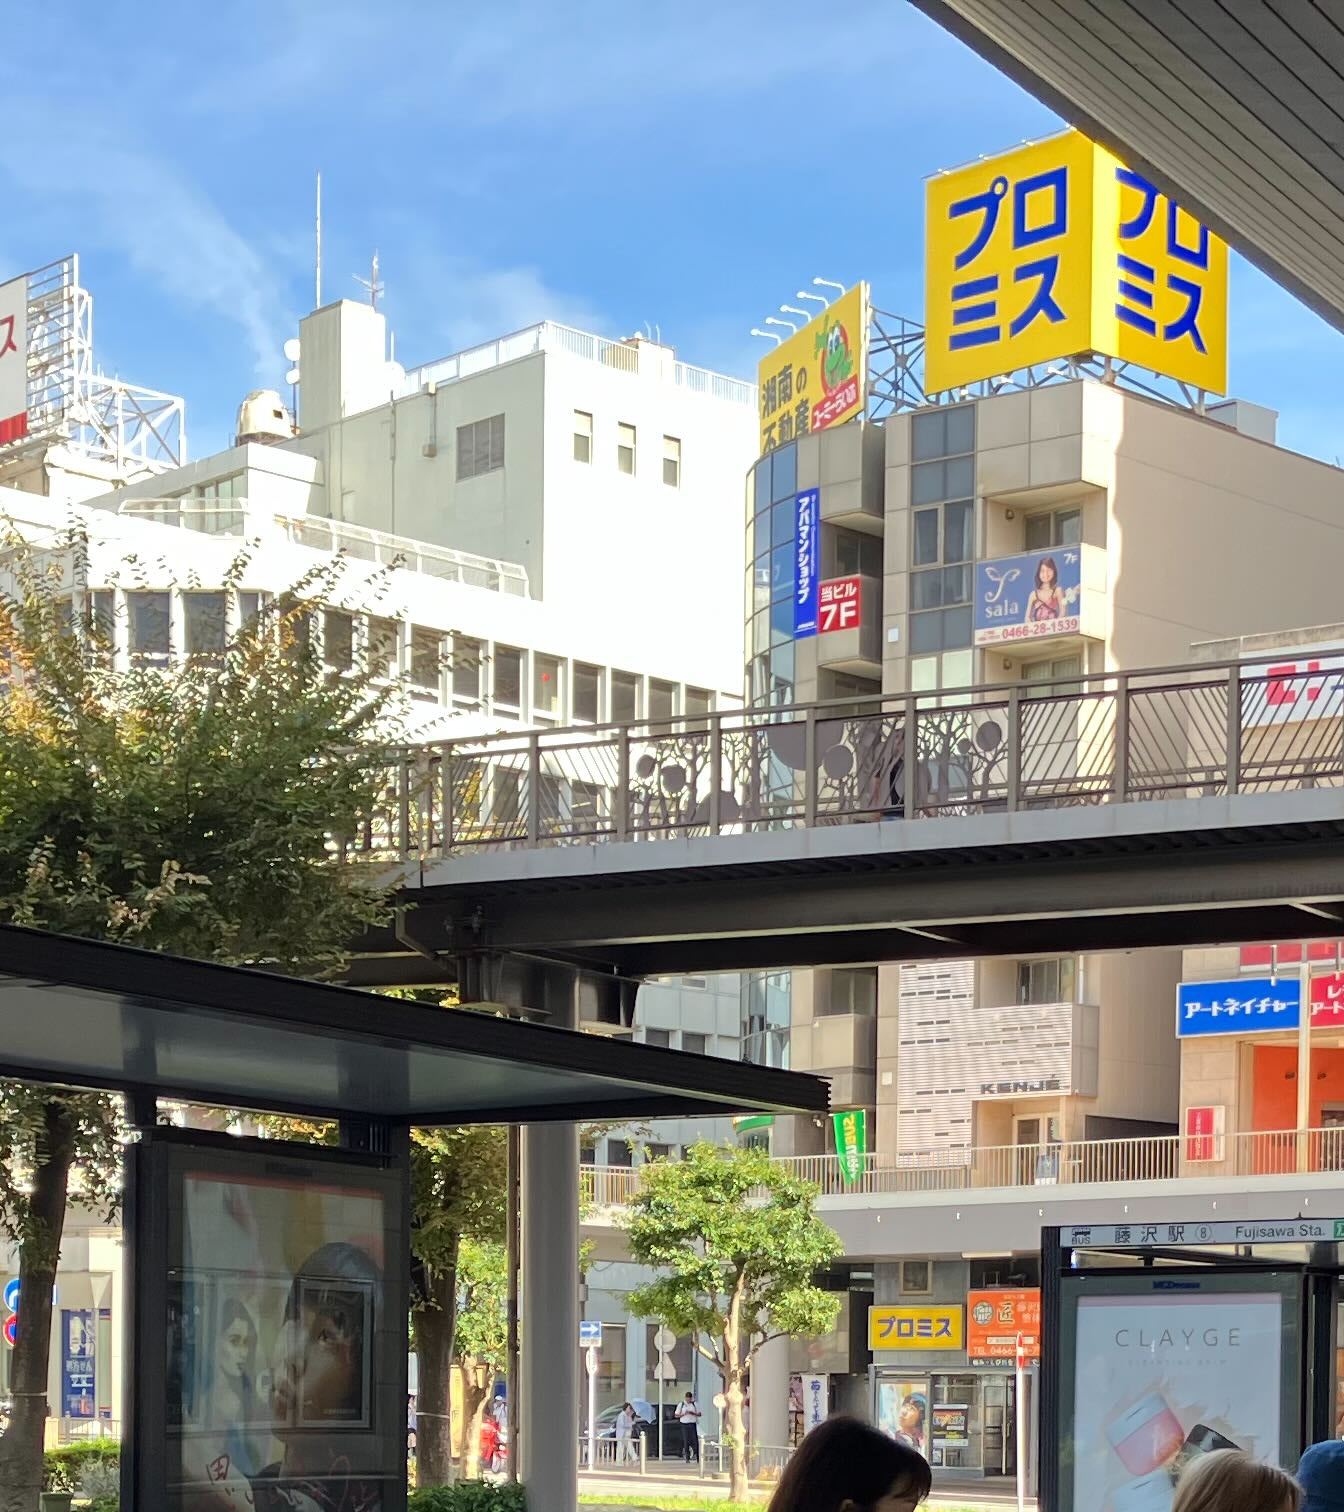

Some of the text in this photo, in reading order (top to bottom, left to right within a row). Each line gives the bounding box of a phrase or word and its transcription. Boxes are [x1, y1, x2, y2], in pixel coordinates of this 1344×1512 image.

[947, 164, 1069, 273] プロ
[948, 253, 1068, 352] ミス
[1114, 253, 1208, 356] ミス
[762, 397, 810, 453] 不動産
[797, 496, 811, 605] アパマンショップ
[1063, 552, 1078, 565] 7F
[820, 582, 857, 603] 当ビル
[819, 599, 857, 631] 7F
[984, 599, 1019, 619] sala
[1002, 617, 1078, 640] 0466-28-1539
[1184, 997, 1299, 1019] アートネイチャー
[1071, 1236, 1091, 1246] BUS
[1114, 1225, 1185, 1245] 藤沢駅
[1235, 1223, 1326, 1241] Fujisawa Sta.
[877, 1315, 953, 1338] プロミス
[1114, 1327, 1242, 1348] CLAYGE
